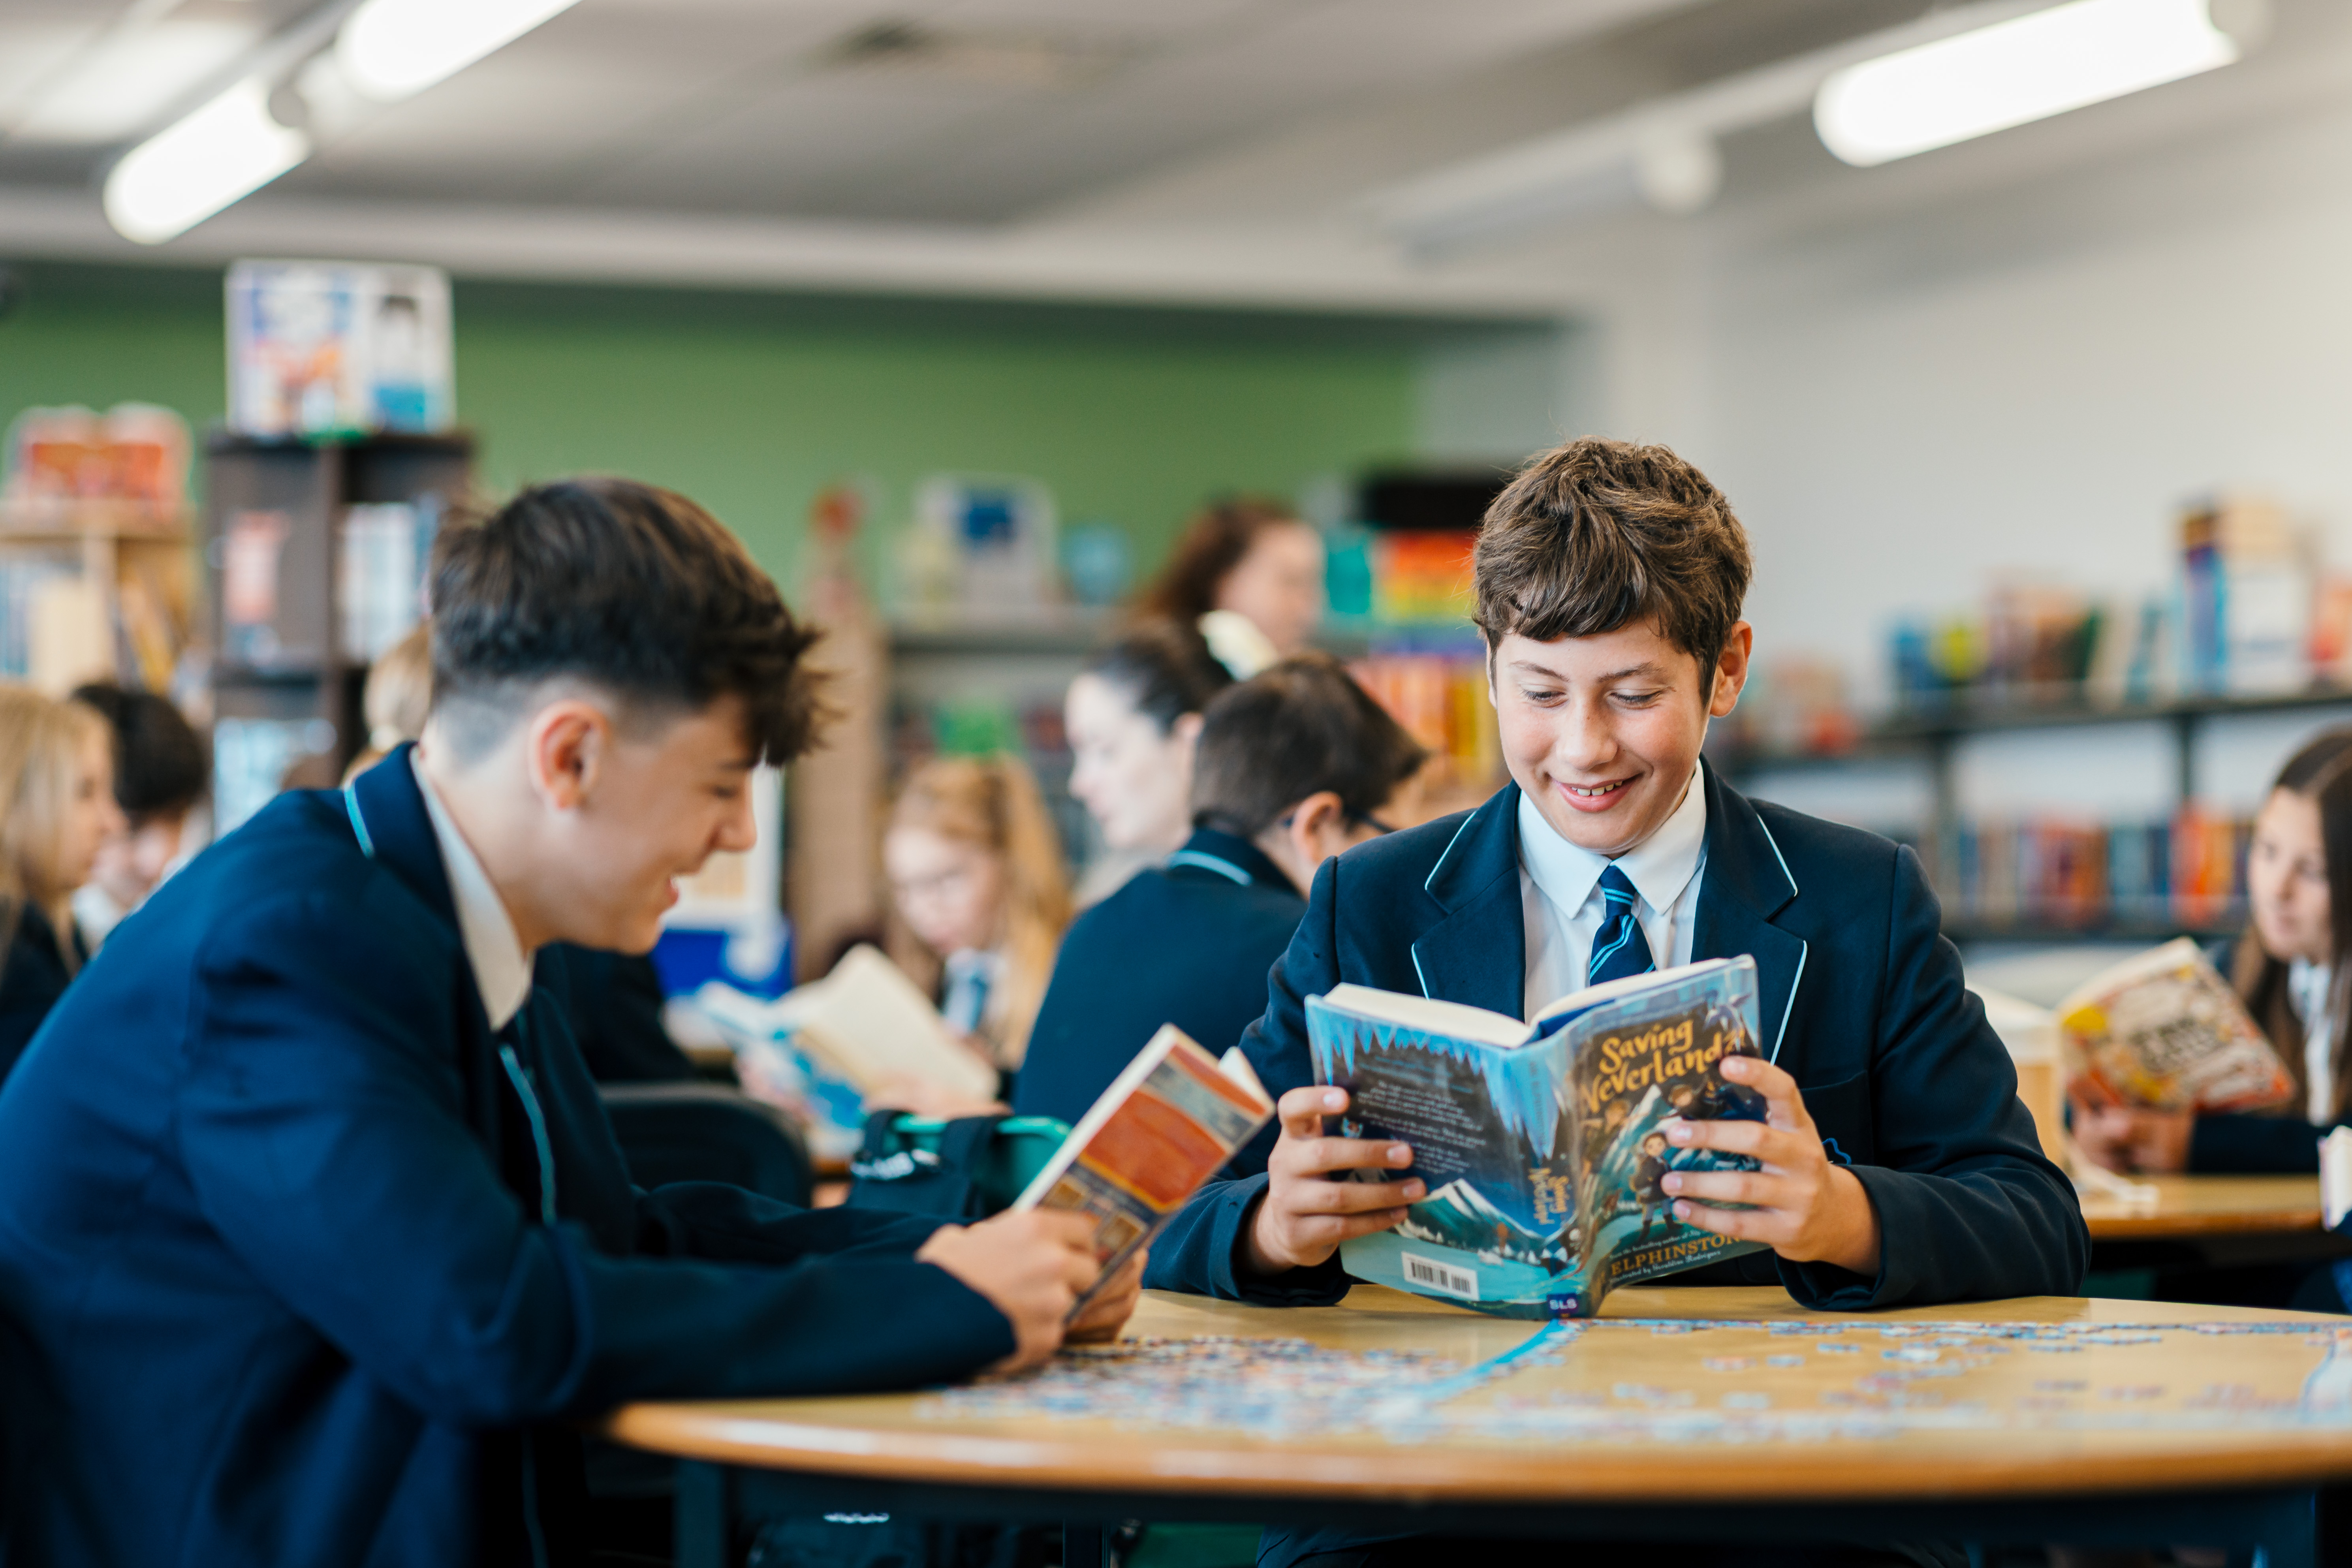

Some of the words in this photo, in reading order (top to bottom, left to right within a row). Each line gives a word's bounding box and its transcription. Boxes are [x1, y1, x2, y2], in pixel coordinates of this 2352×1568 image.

[1599, 1019, 1693, 1074] Saving
[1581, 1031, 1723, 1114] Neverland
[1611, 1233, 1740, 1277] ELPHINSTON
[1632, 1241, 1662, 1251] bestselling
[1662, 1236, 1681, 1245] author
